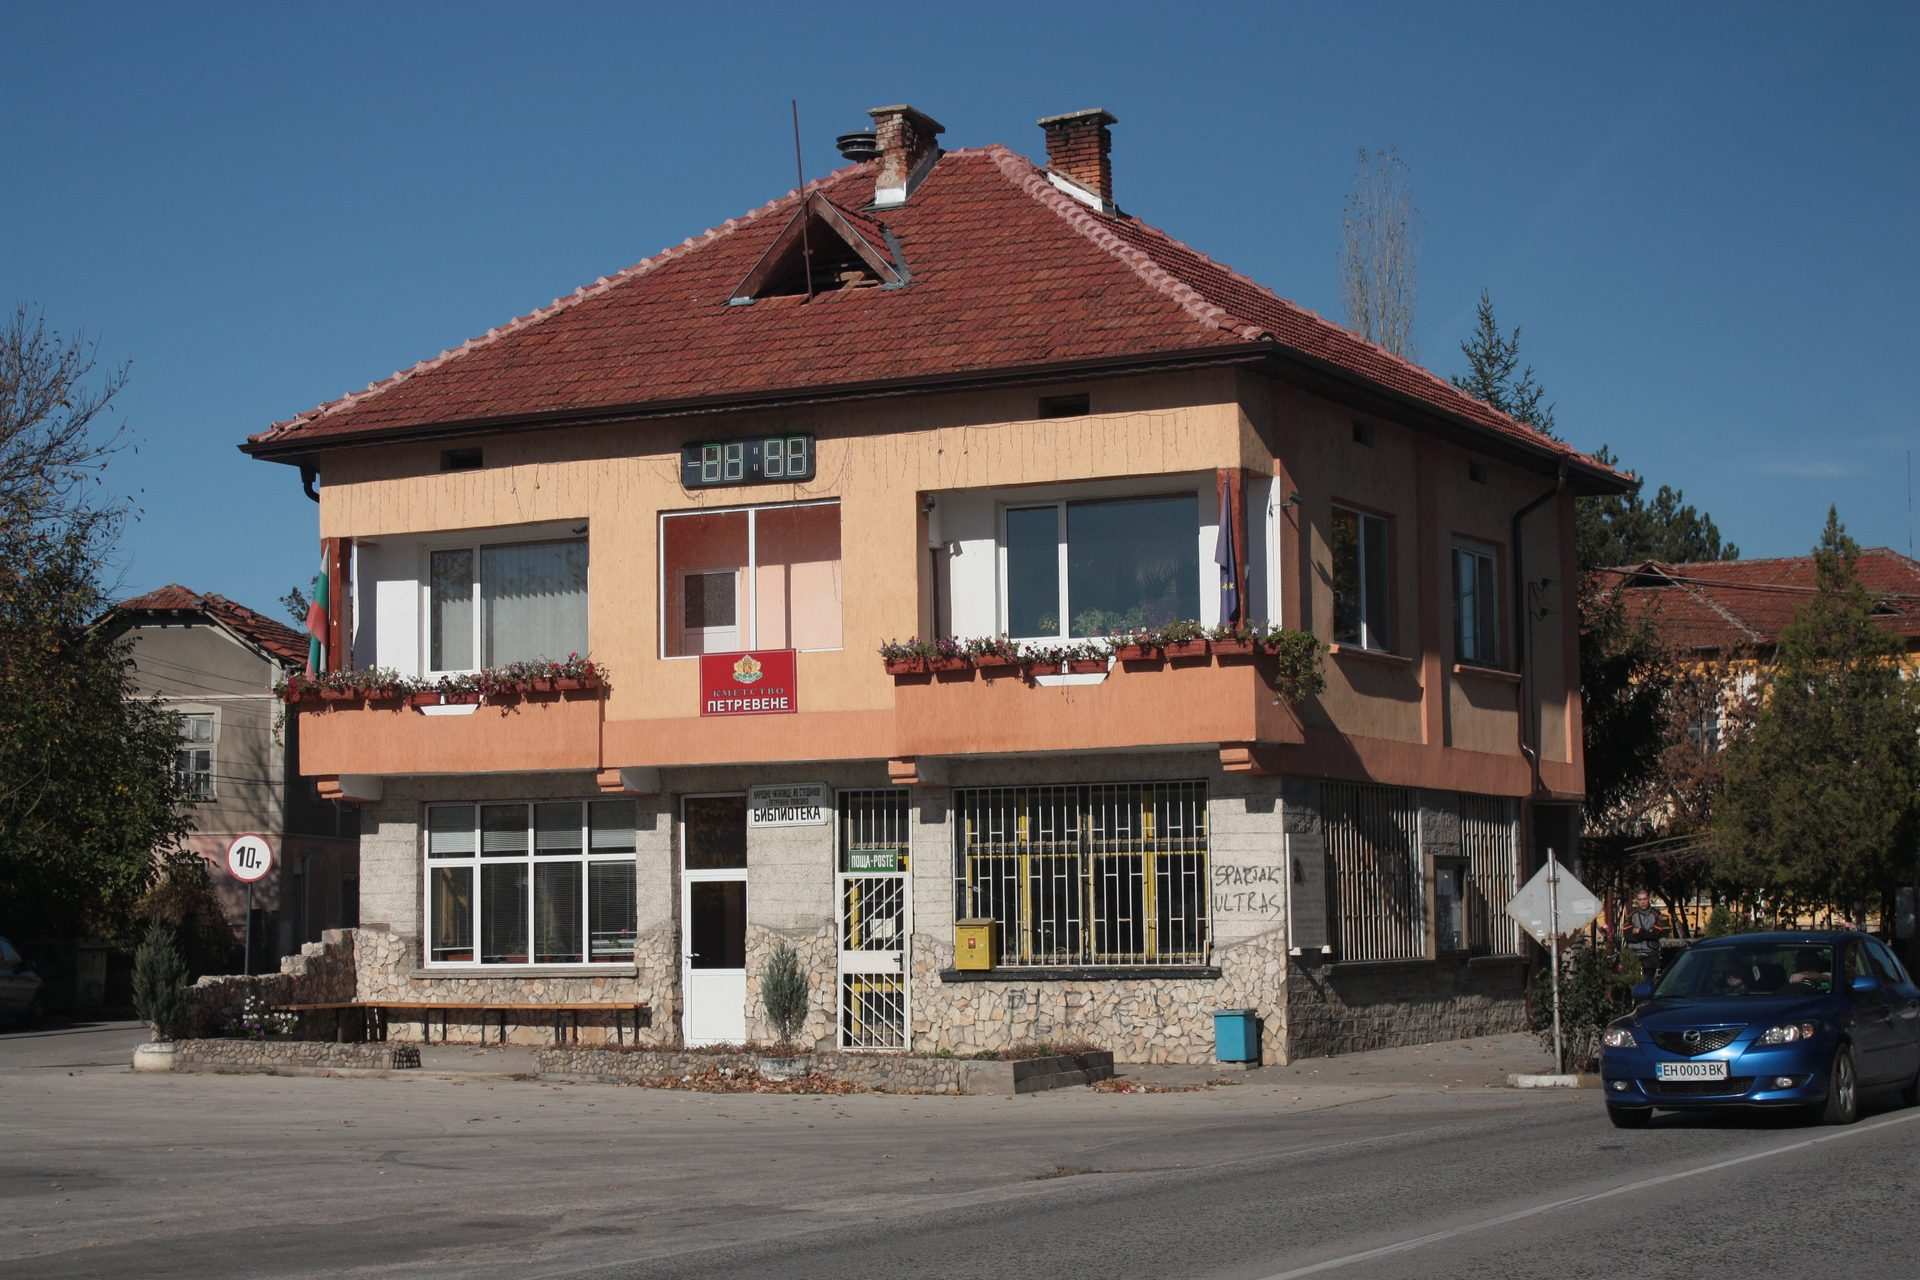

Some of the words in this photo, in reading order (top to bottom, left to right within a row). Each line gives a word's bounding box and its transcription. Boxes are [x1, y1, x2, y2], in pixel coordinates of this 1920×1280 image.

[707, 697, 789, 713] ПЕТРЕВЕНЕ
[753, 806, 821, 822] БИБЛИОТЕКА
[1214, 891, 1281, 920] ULTRAS
[1680, 1065, 1707, 1076] 0003
